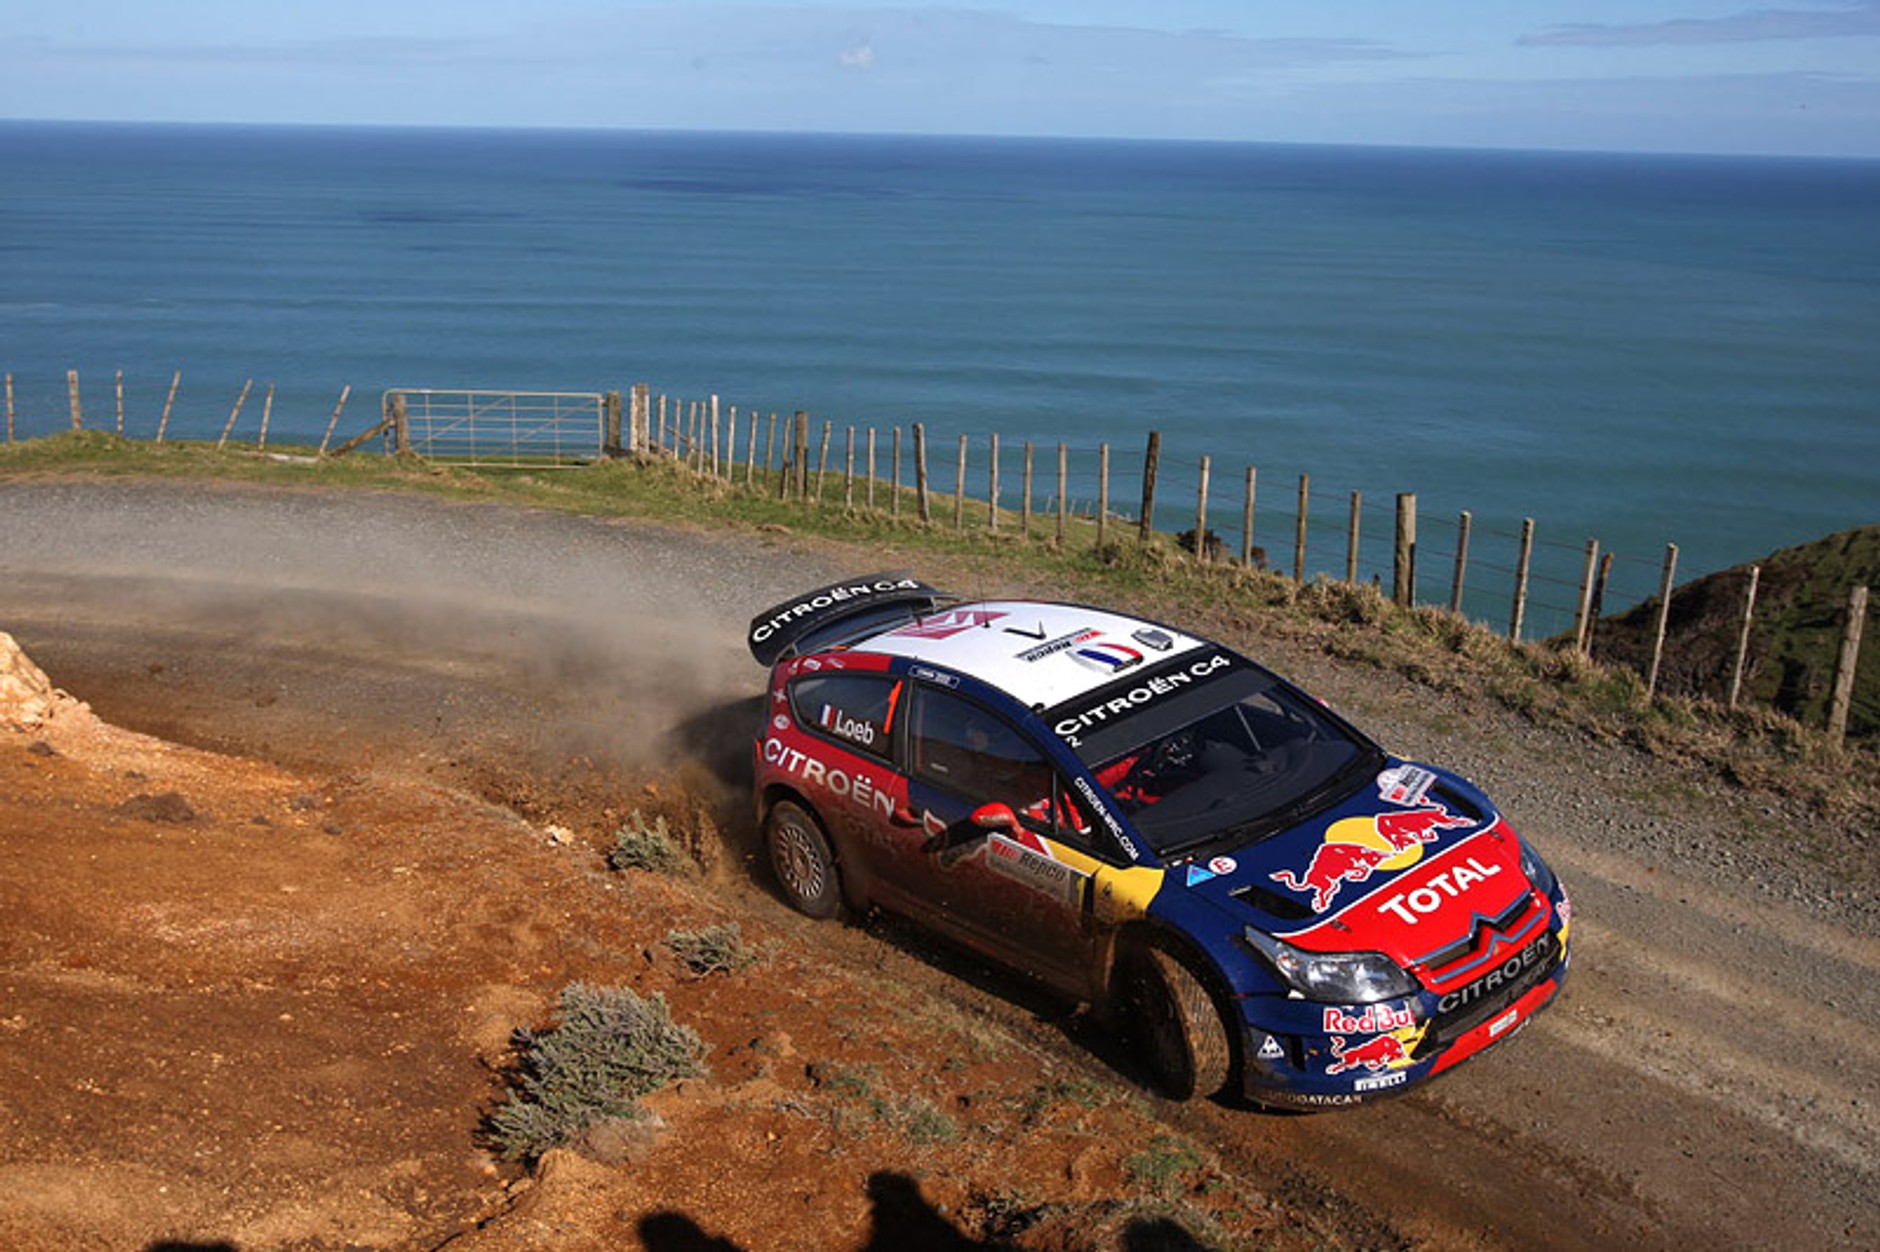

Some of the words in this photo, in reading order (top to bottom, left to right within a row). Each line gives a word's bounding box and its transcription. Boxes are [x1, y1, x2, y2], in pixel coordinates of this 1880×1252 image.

[752, 586, 872, 642] CITROËN
[873, 579, 919, 592] C4
[1054, 672, 1192, 735] CITROËN
[1190, 655, 1231, 676] C4
[834, 709, 874, 745] Loeb
[764, 738, 896, 818] CITROËN
[1020, 851, 1066, 883] Repco
[1377, 858, 1501, 924] TOTAL
[1324, 1005, 1375, 1033] Red
